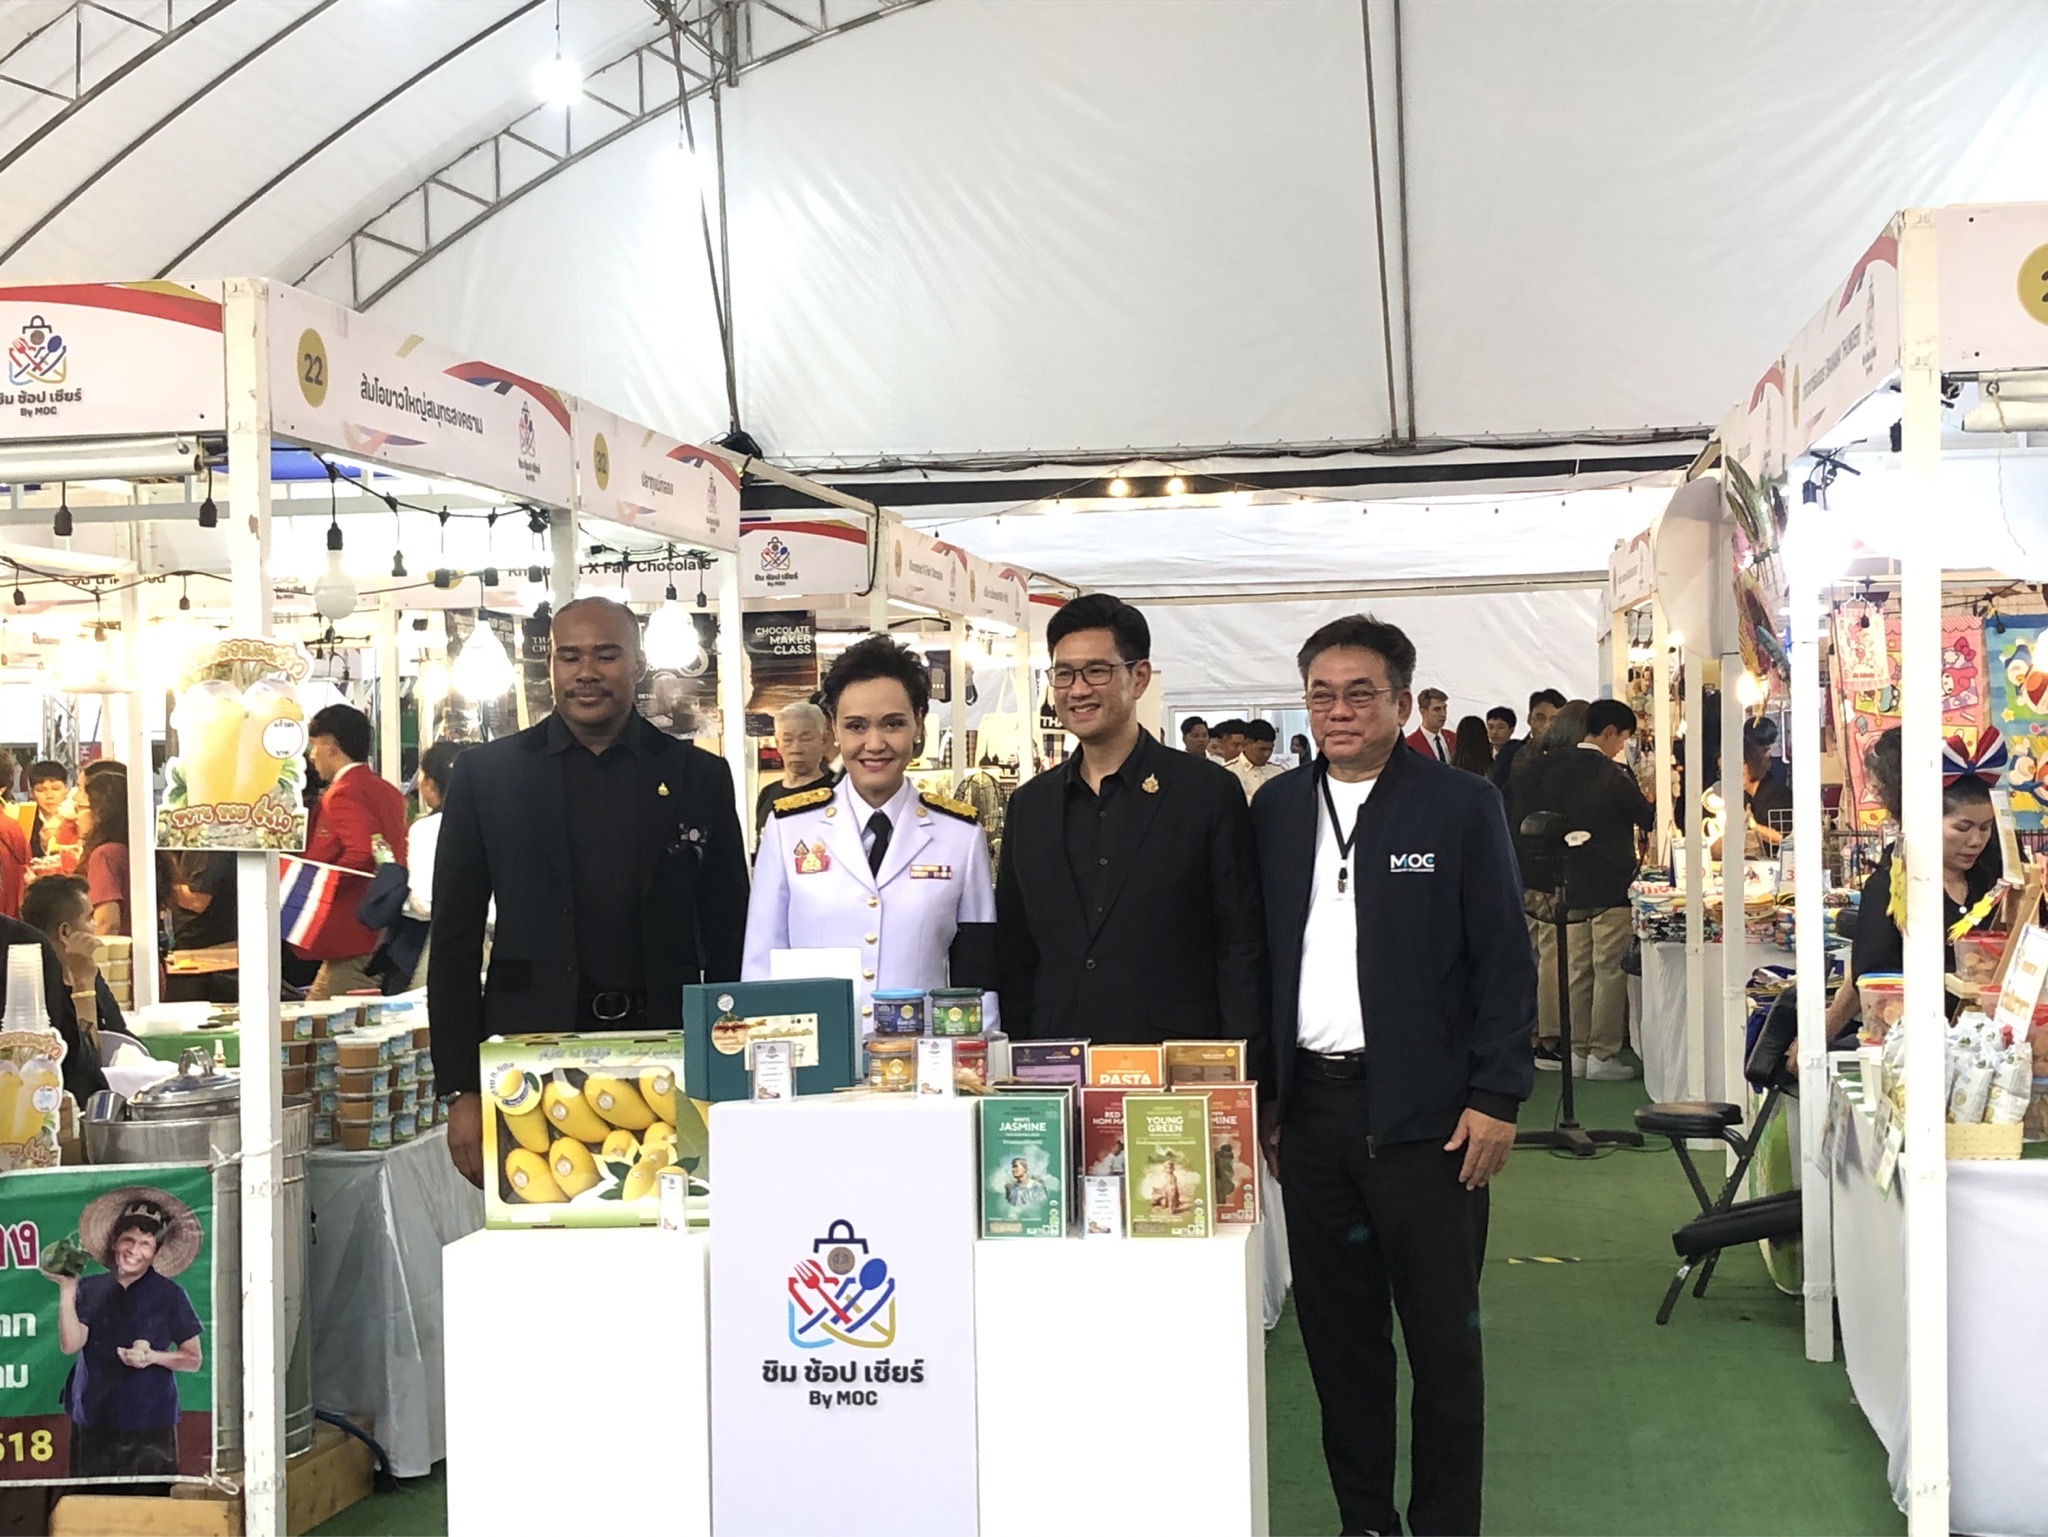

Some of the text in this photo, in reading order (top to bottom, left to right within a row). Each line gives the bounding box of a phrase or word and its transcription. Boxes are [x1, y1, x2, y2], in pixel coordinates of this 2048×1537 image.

[303, 353, 324, 386] 22
[20, 406, 58, 418] By MOC
[636, 559, 712, 574] Chocolate
[755, 625, 811, 636] CHOCOLATE
[769, 634, 812, 645] MAKER
[773, 644, 813, 655] CLASS
[1389, 853, 1435, 869] MOC
[1099, 1074, 1152, 1085] PASTA
[1146, 1116, 1184, 1125] YOUNG
[998, 1122, 1047, 1132] JASMINE
[1147, 1124, 1183, 1133] GREEN
[762, 1357, 925, 1383] ชิม ช้อป เชียร์
[809, 1390, 878, 1409] By MOC
